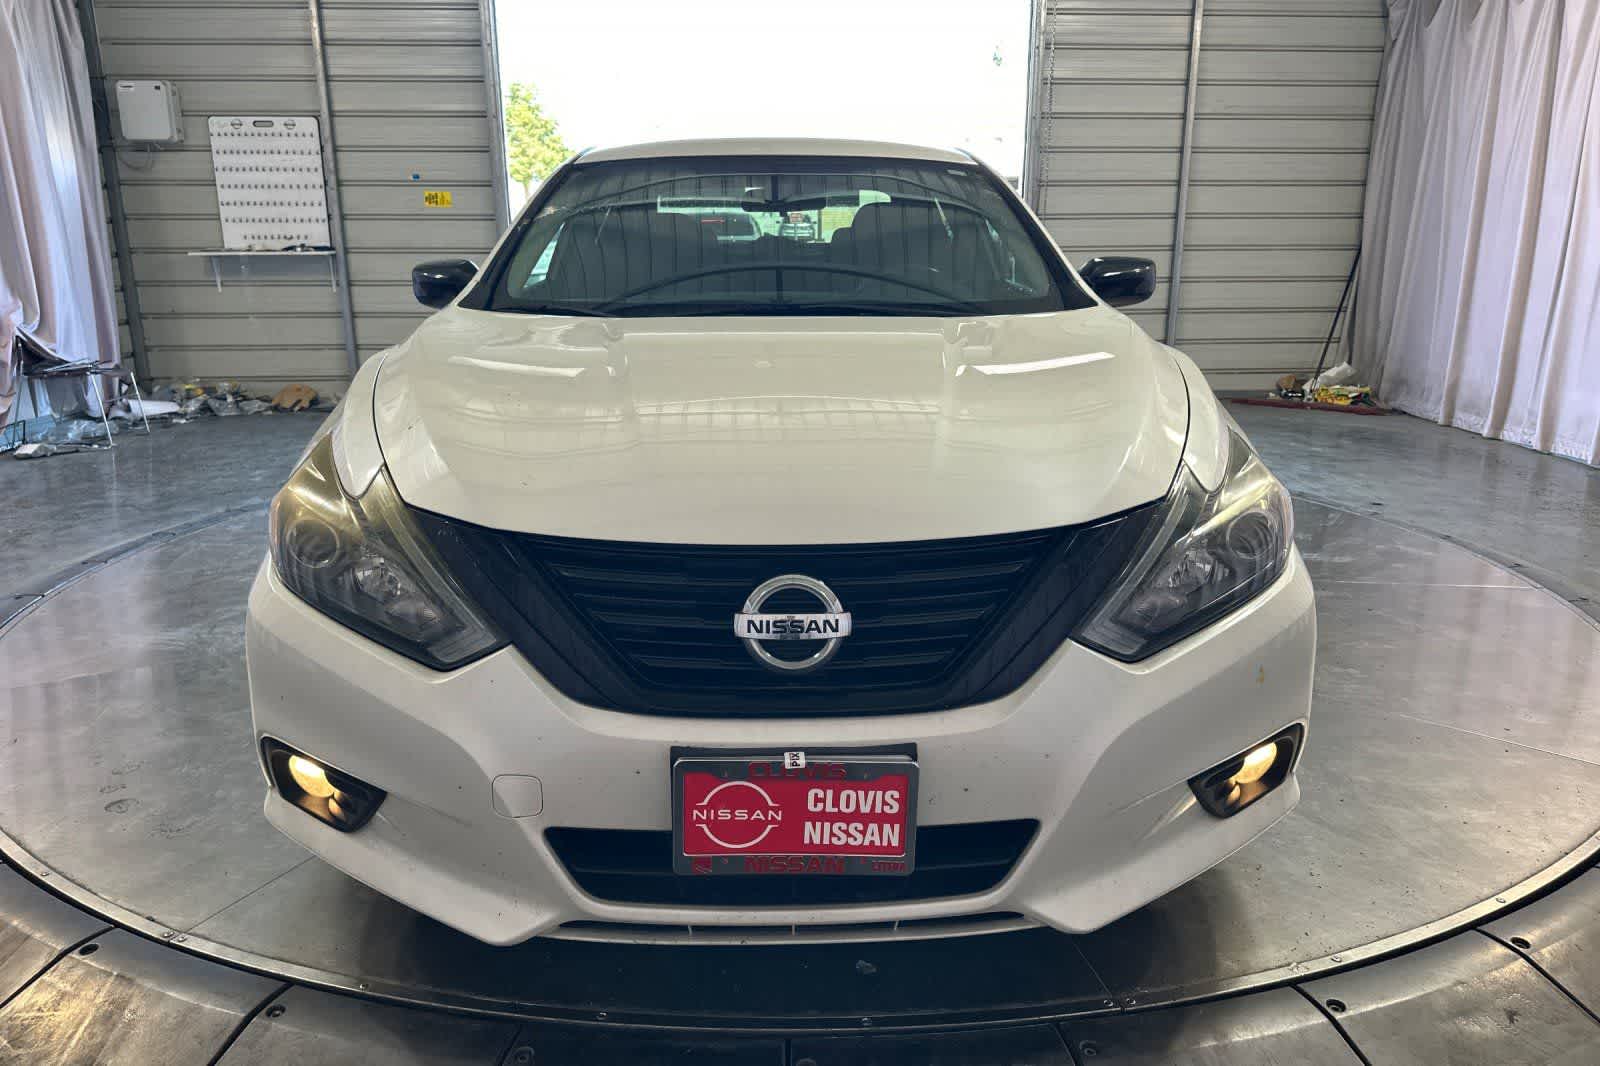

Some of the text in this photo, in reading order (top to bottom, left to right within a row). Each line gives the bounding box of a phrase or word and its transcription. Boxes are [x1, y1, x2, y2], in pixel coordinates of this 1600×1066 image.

[746, 618, 840, 634] NISSAN
[791, 752, 801, 767] PIX
[807, 788, 900, 814] CLOVIS
[692, 809, 782, 821] NISSAN
[803, 821, 900, 847] NISSAN
[743, 855, 845, 874] NISSAN
